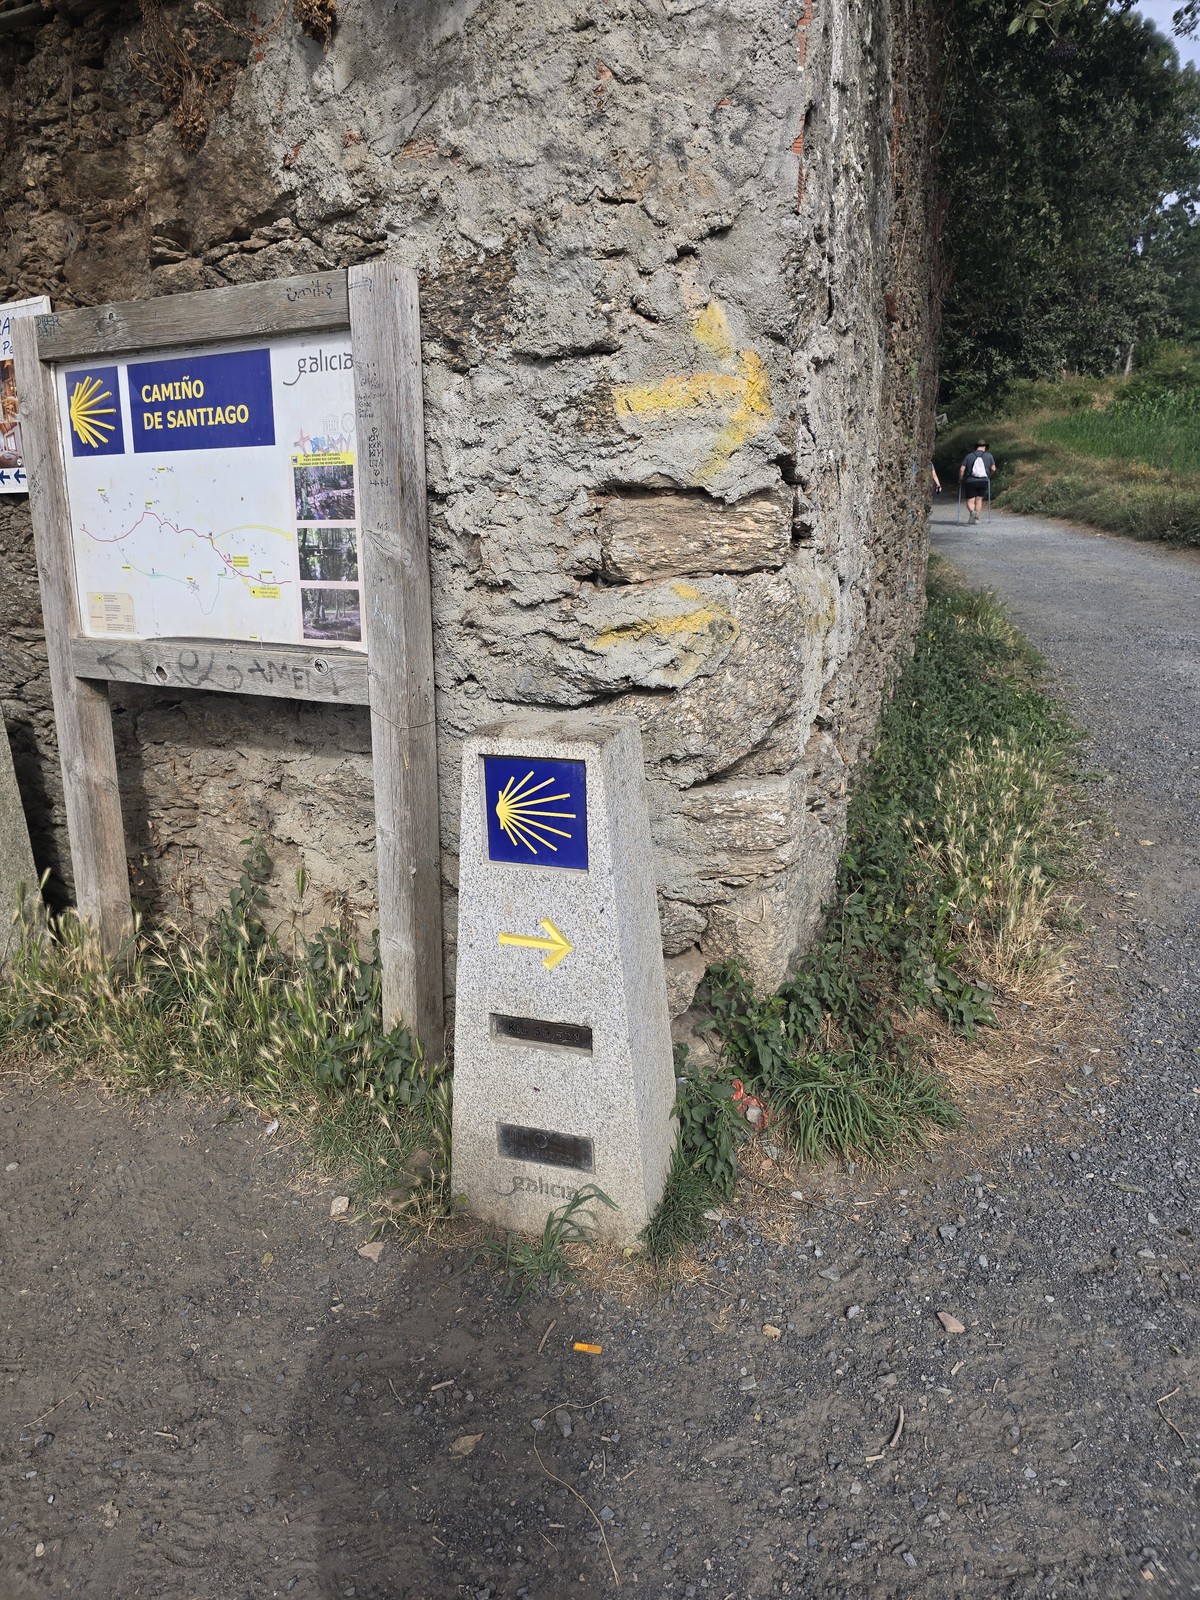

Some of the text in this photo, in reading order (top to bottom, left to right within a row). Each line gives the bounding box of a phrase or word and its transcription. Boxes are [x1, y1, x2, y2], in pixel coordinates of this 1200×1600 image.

[282, 348, 354, 386] galicia
[141, 375, 205, 403] CAMIÑO
[143, 404, 249, 430] DE SANTIAGO
